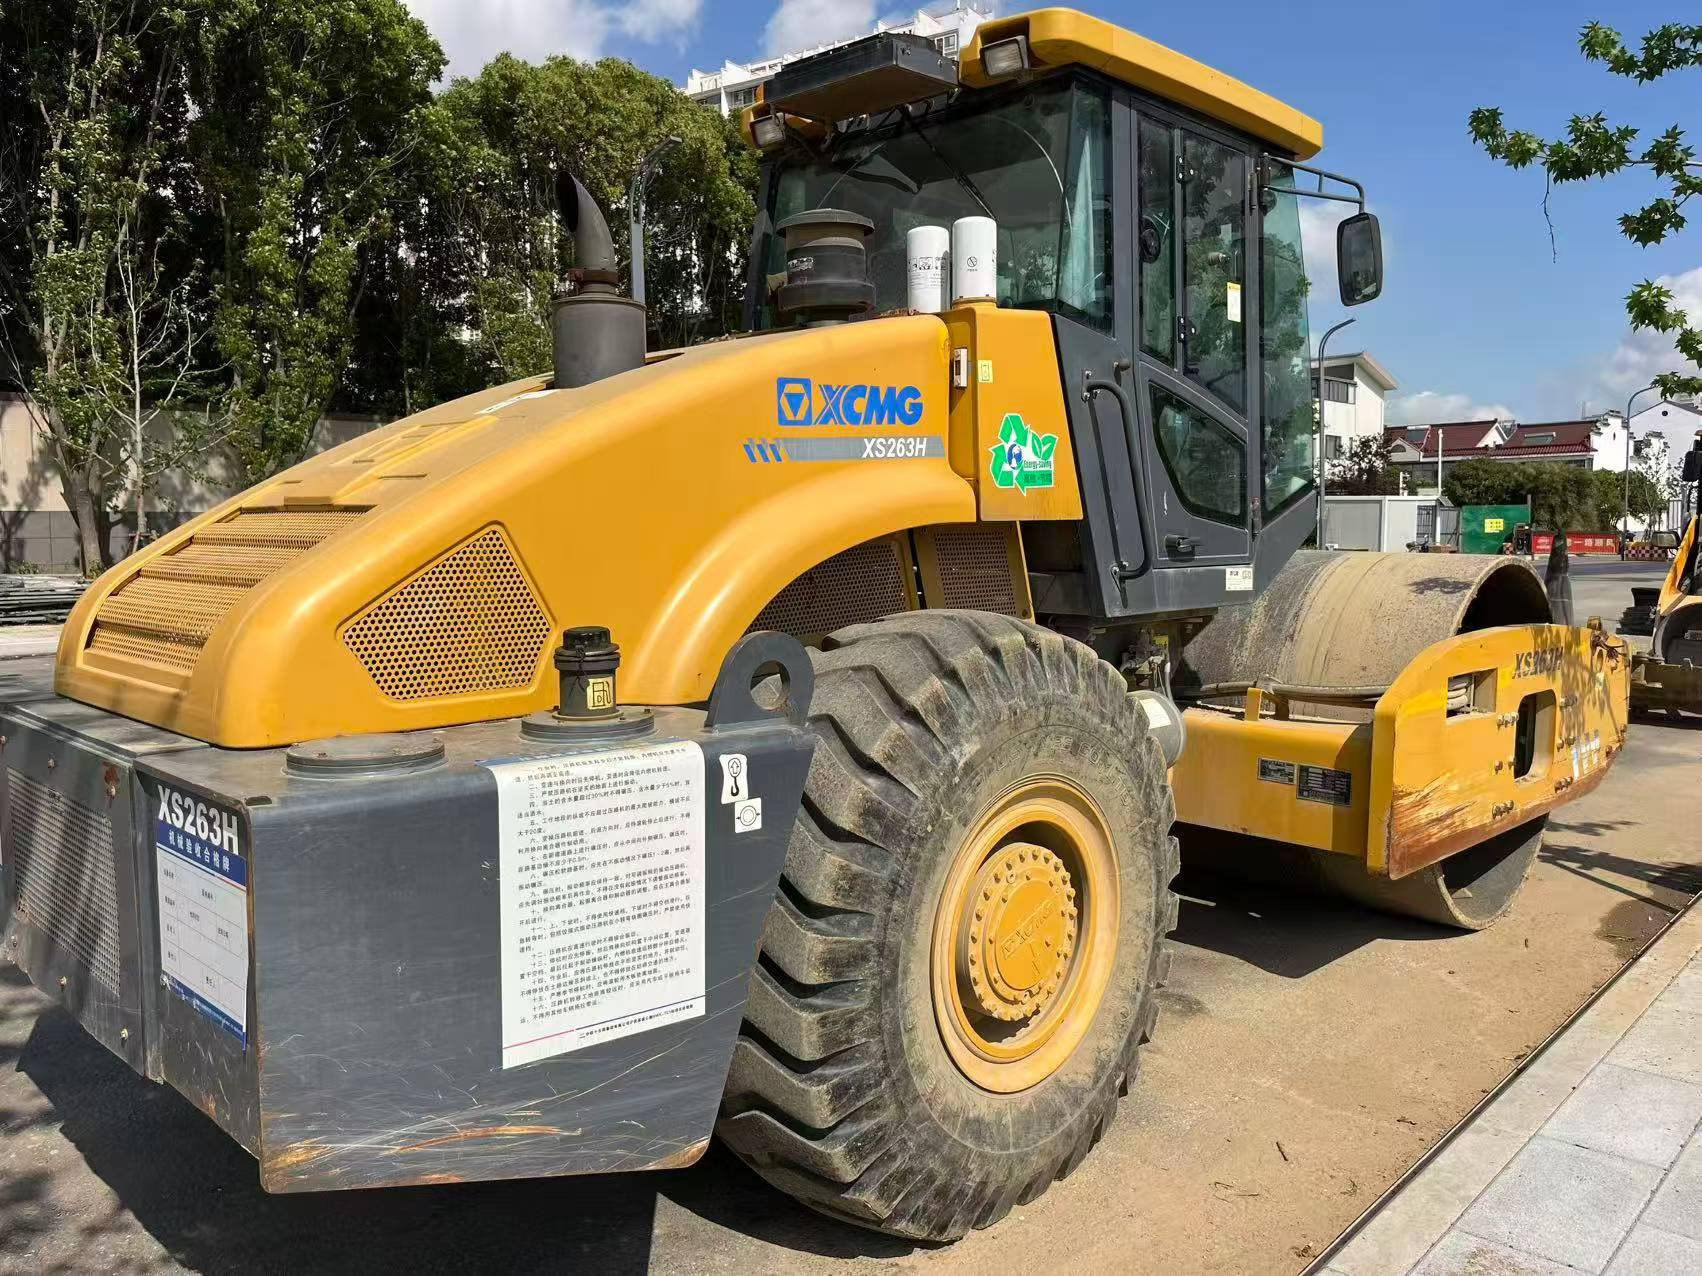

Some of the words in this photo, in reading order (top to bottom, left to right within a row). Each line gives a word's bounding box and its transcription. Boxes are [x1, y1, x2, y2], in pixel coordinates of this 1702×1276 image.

[813, 385, 923, 425] XCMG
[862, 437, 928, 459] XS263H
[1512, 646, 1563, 679] XS263H
[157, 785, 239, 856] XS263H
[168, 829, 230, 872] 机械验收合格牌
